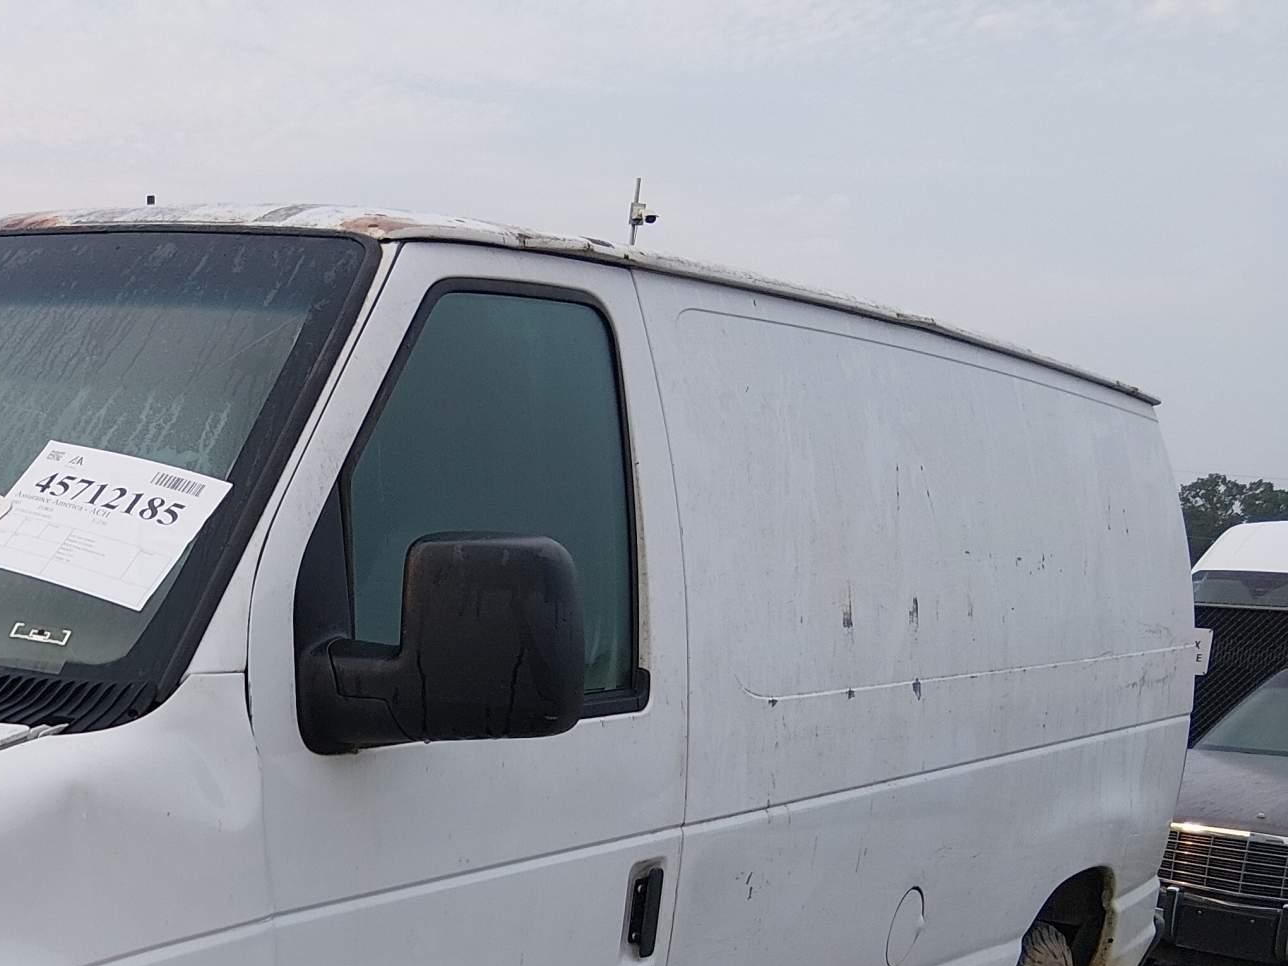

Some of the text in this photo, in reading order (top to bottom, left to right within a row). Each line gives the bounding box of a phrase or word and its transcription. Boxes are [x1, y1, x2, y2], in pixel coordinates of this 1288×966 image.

[35, 473, 186, 525] 45712185
[53, 498, 84, 511] America
[89, 508, 111, 519] ACH
